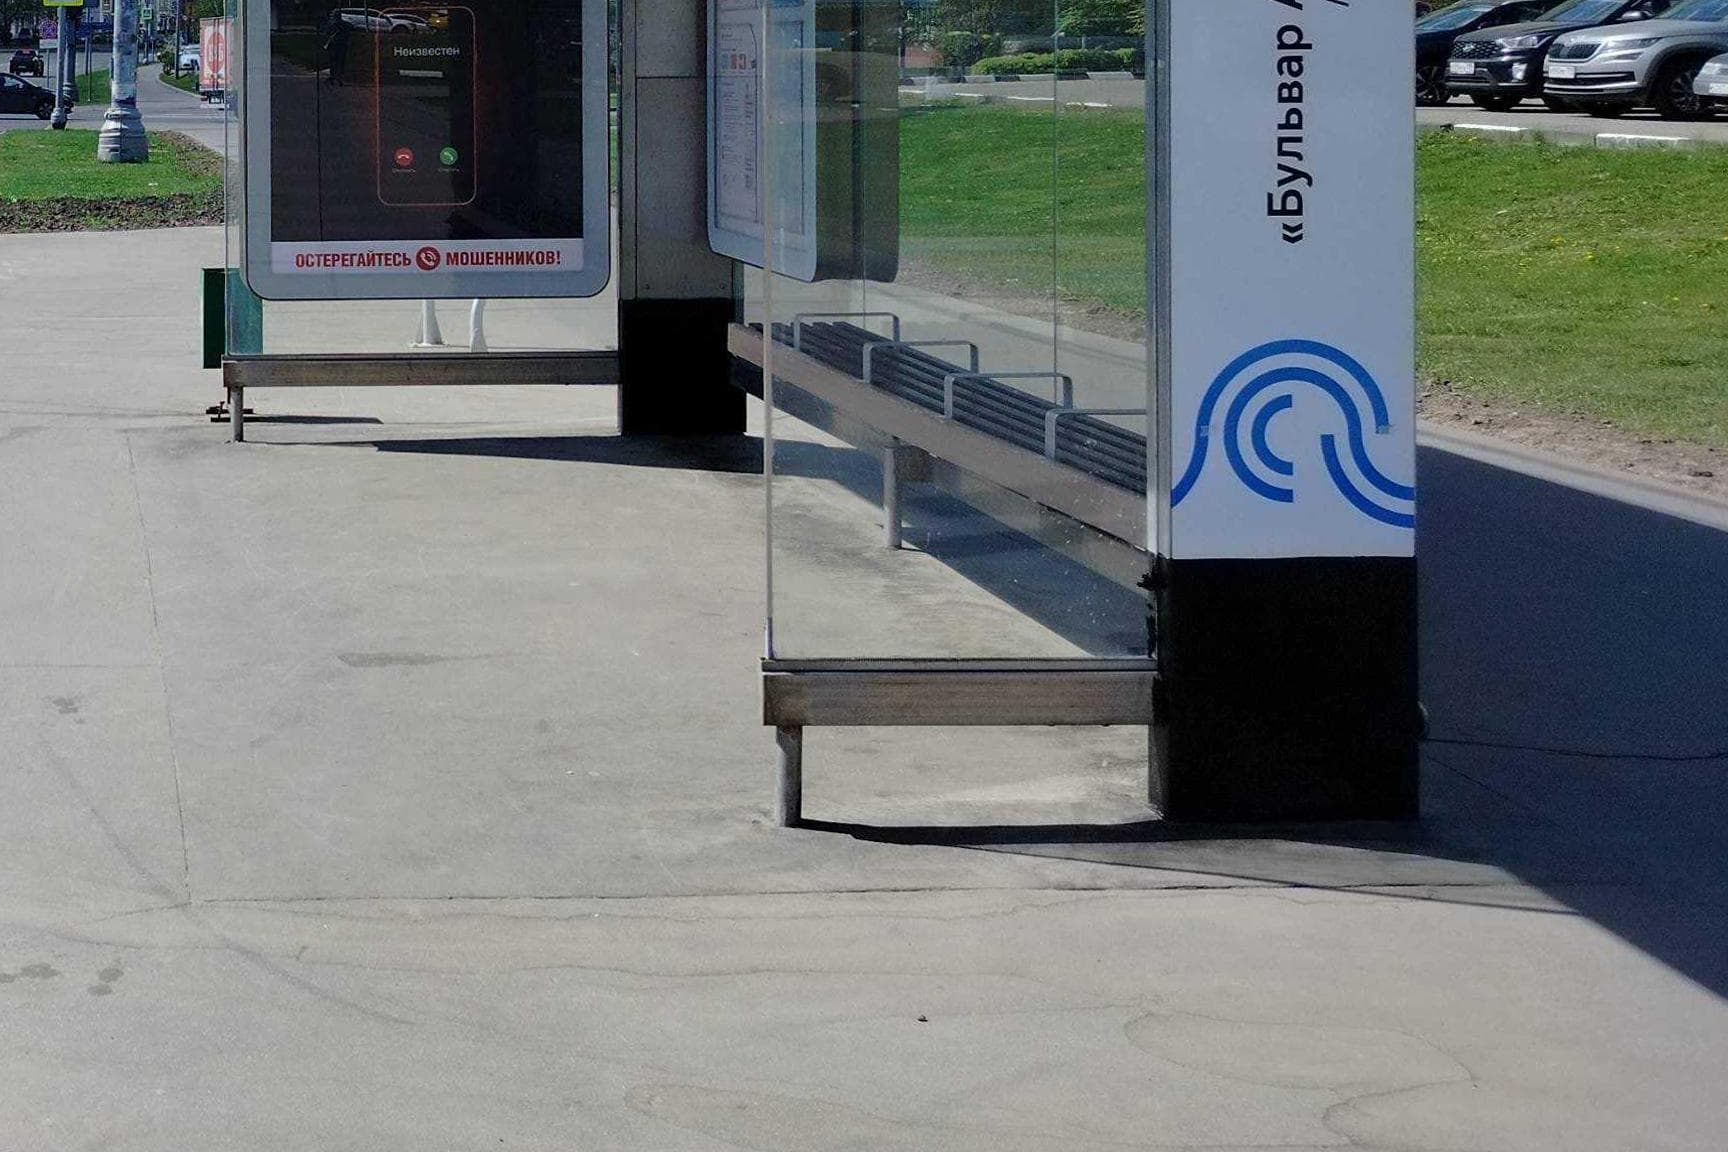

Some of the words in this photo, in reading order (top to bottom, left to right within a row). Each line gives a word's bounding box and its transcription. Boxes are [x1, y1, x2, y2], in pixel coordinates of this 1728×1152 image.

[393, 47, 460, 57] Неизвестен
[1266, 24, 1314, 245] «Бульвар
[295, 249, 411, 268] ОСТЕРЕГАЙТЕСЬ
[446, 250, 561, 266] МОШЕННИКОВ!
